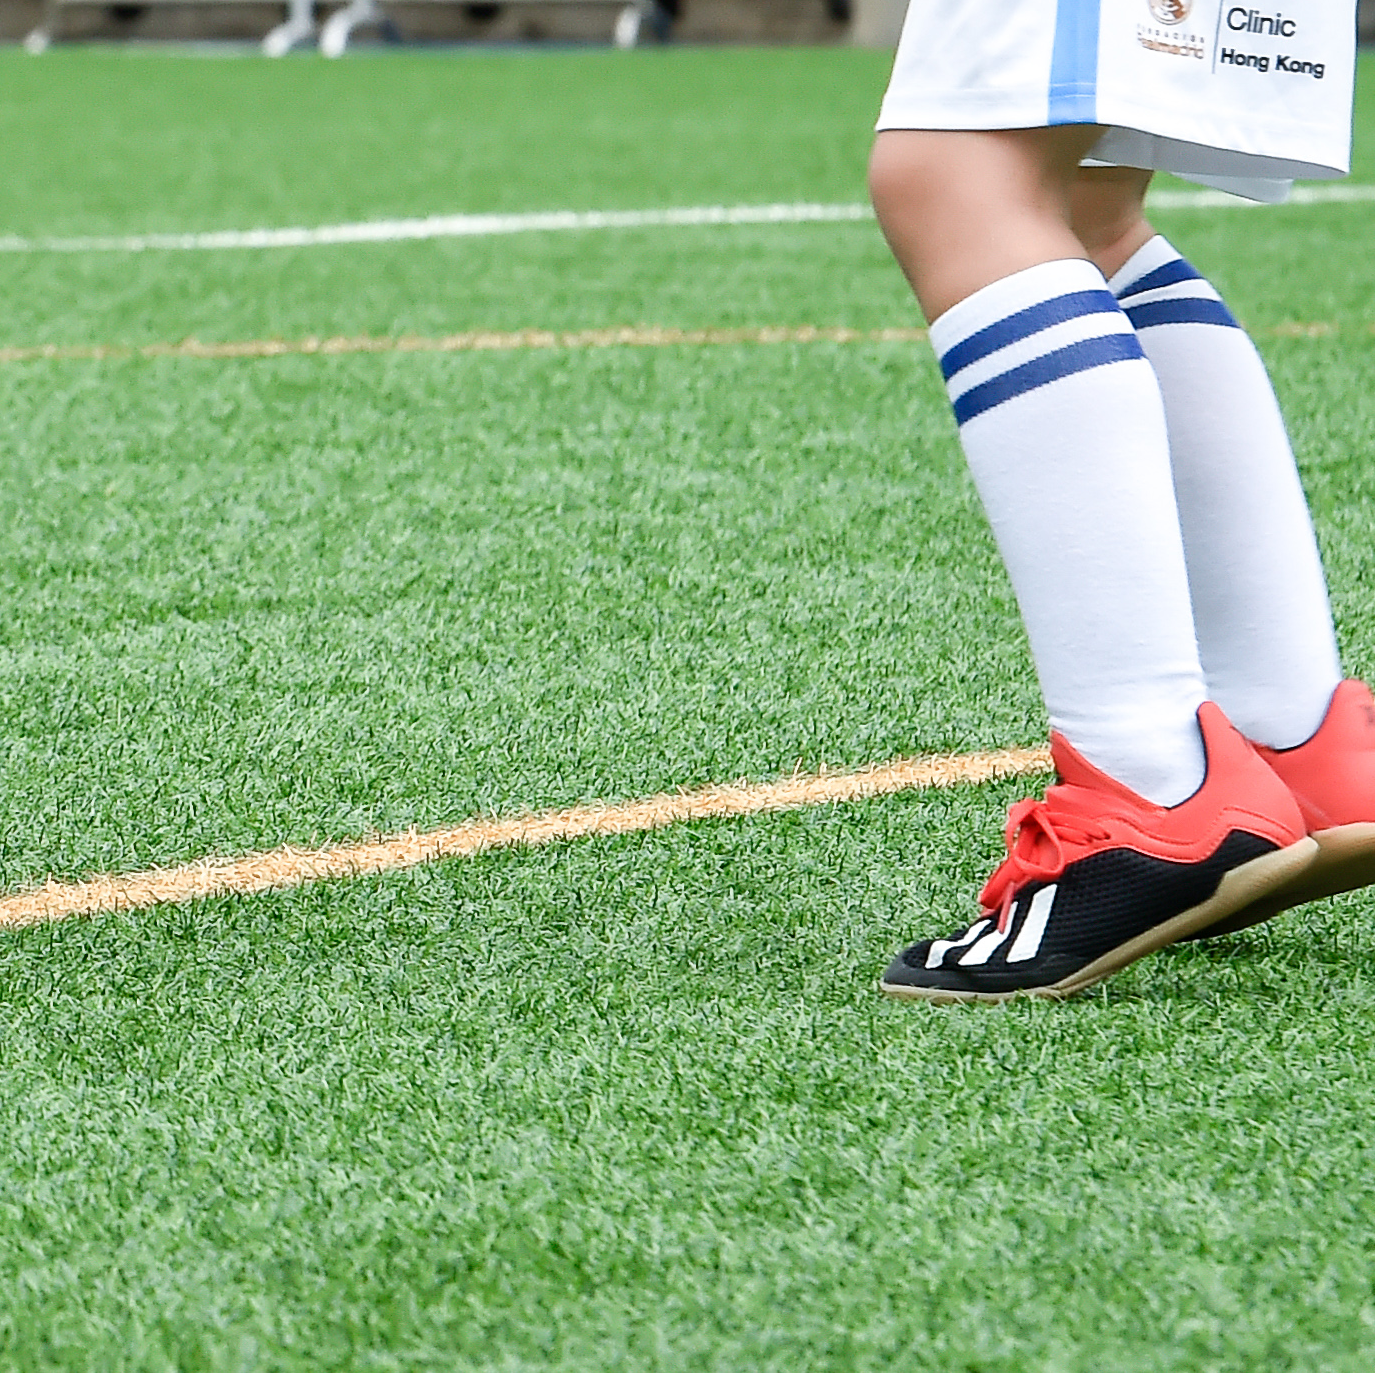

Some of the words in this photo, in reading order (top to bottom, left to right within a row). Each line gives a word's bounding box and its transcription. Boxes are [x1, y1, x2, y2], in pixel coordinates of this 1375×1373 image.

[1226, 7, 1297, 37] Clinic
[1220, 47, 1270, 72] Hong
[1275, 54, 1325, 79] Kong
